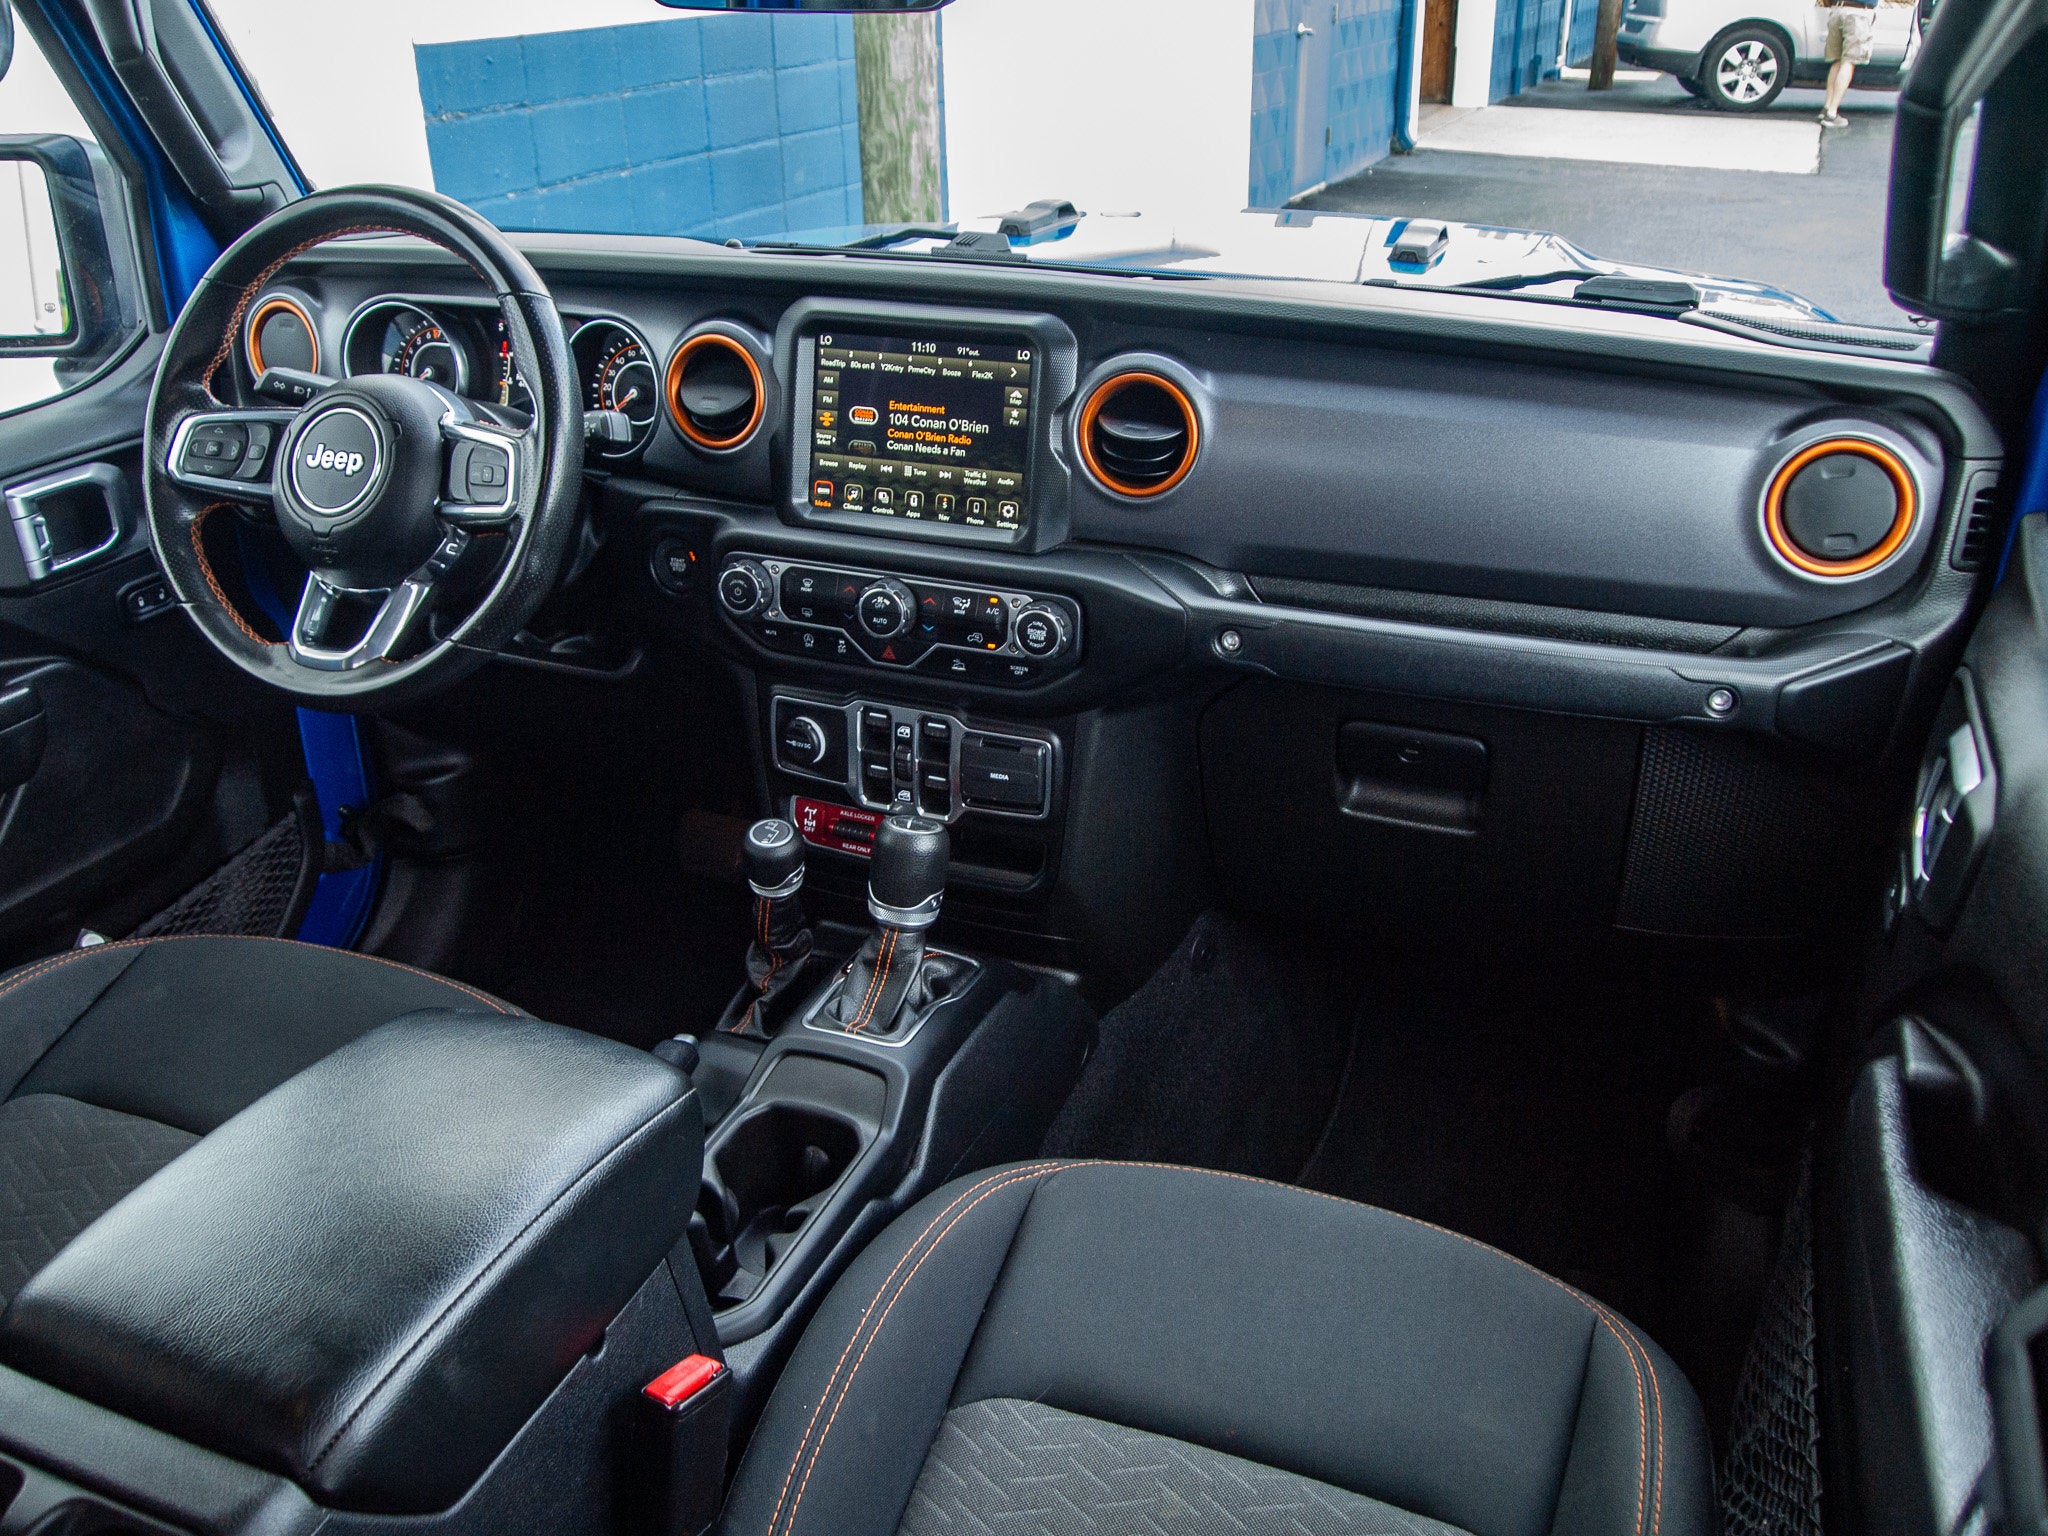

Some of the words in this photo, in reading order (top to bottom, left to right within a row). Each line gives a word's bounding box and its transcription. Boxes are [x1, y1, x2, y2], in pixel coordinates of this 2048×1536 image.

[416, 337, 421, 345] 5
[820, 335, 832, 345] LO
[911, 342, 937, 353] 11:10
[1017, 350, 1030, 360] LO
[405, 359, 409, 367] 3
[821, 359, 846, 368] RoadTrip
[850, 361, 861, 369] 80s
[943, 368, 961, 377] Booze
[823, 376, 834, 384] AM
[822, 396, 833, 404] FM
[1009, 398, 1022, 406] Map
[889, 400, 945, 415] Entertainment
[889, 413, 909, 427] 104
[911, 415, 946, 430] Conan
[948, 418, 989, 434] O'Brien
[816, 432, 832, 440] Source
[887, 429, 914, 440] Conan
[915, 431, 946, 443] O'Brien
[948, 435, 972, 446] Radio
[886, 440, 914, 452] Conan
[915, 443, 941, 455] Needs
[950, 446, 966, 457] Fan
[306, 443, 363, 476] Jeep
[819, 459, 838, 468] Browse
[848, 462, 867, 471] Replay
[913, 468, 927, 476] Tune
[964, 470, 981, 478] Traffic
[963, 477, 988, 486] Weather
[997, 477, 1015, 486] Audio
[814, 500, 832, 508] Media
[843, 503, 864, 512] Climate
[872, 506, 894, 515] Controls
[906, 510, 920, 519] Apps
[938, 514, 950, 522] Nav
[966, 517, 985, 526] Phone
[996, 520, 1019, 529] Settings
[986, 607, 1000, 615] A/C
[990, 772, 1009, 781] MEDIA
[840, 810, 853, 818] AXLE
[854, 813, 876, 822] LOCKER
[842, 842, 857, 851] REAR
[857, 846, 871, 854] ONLY
